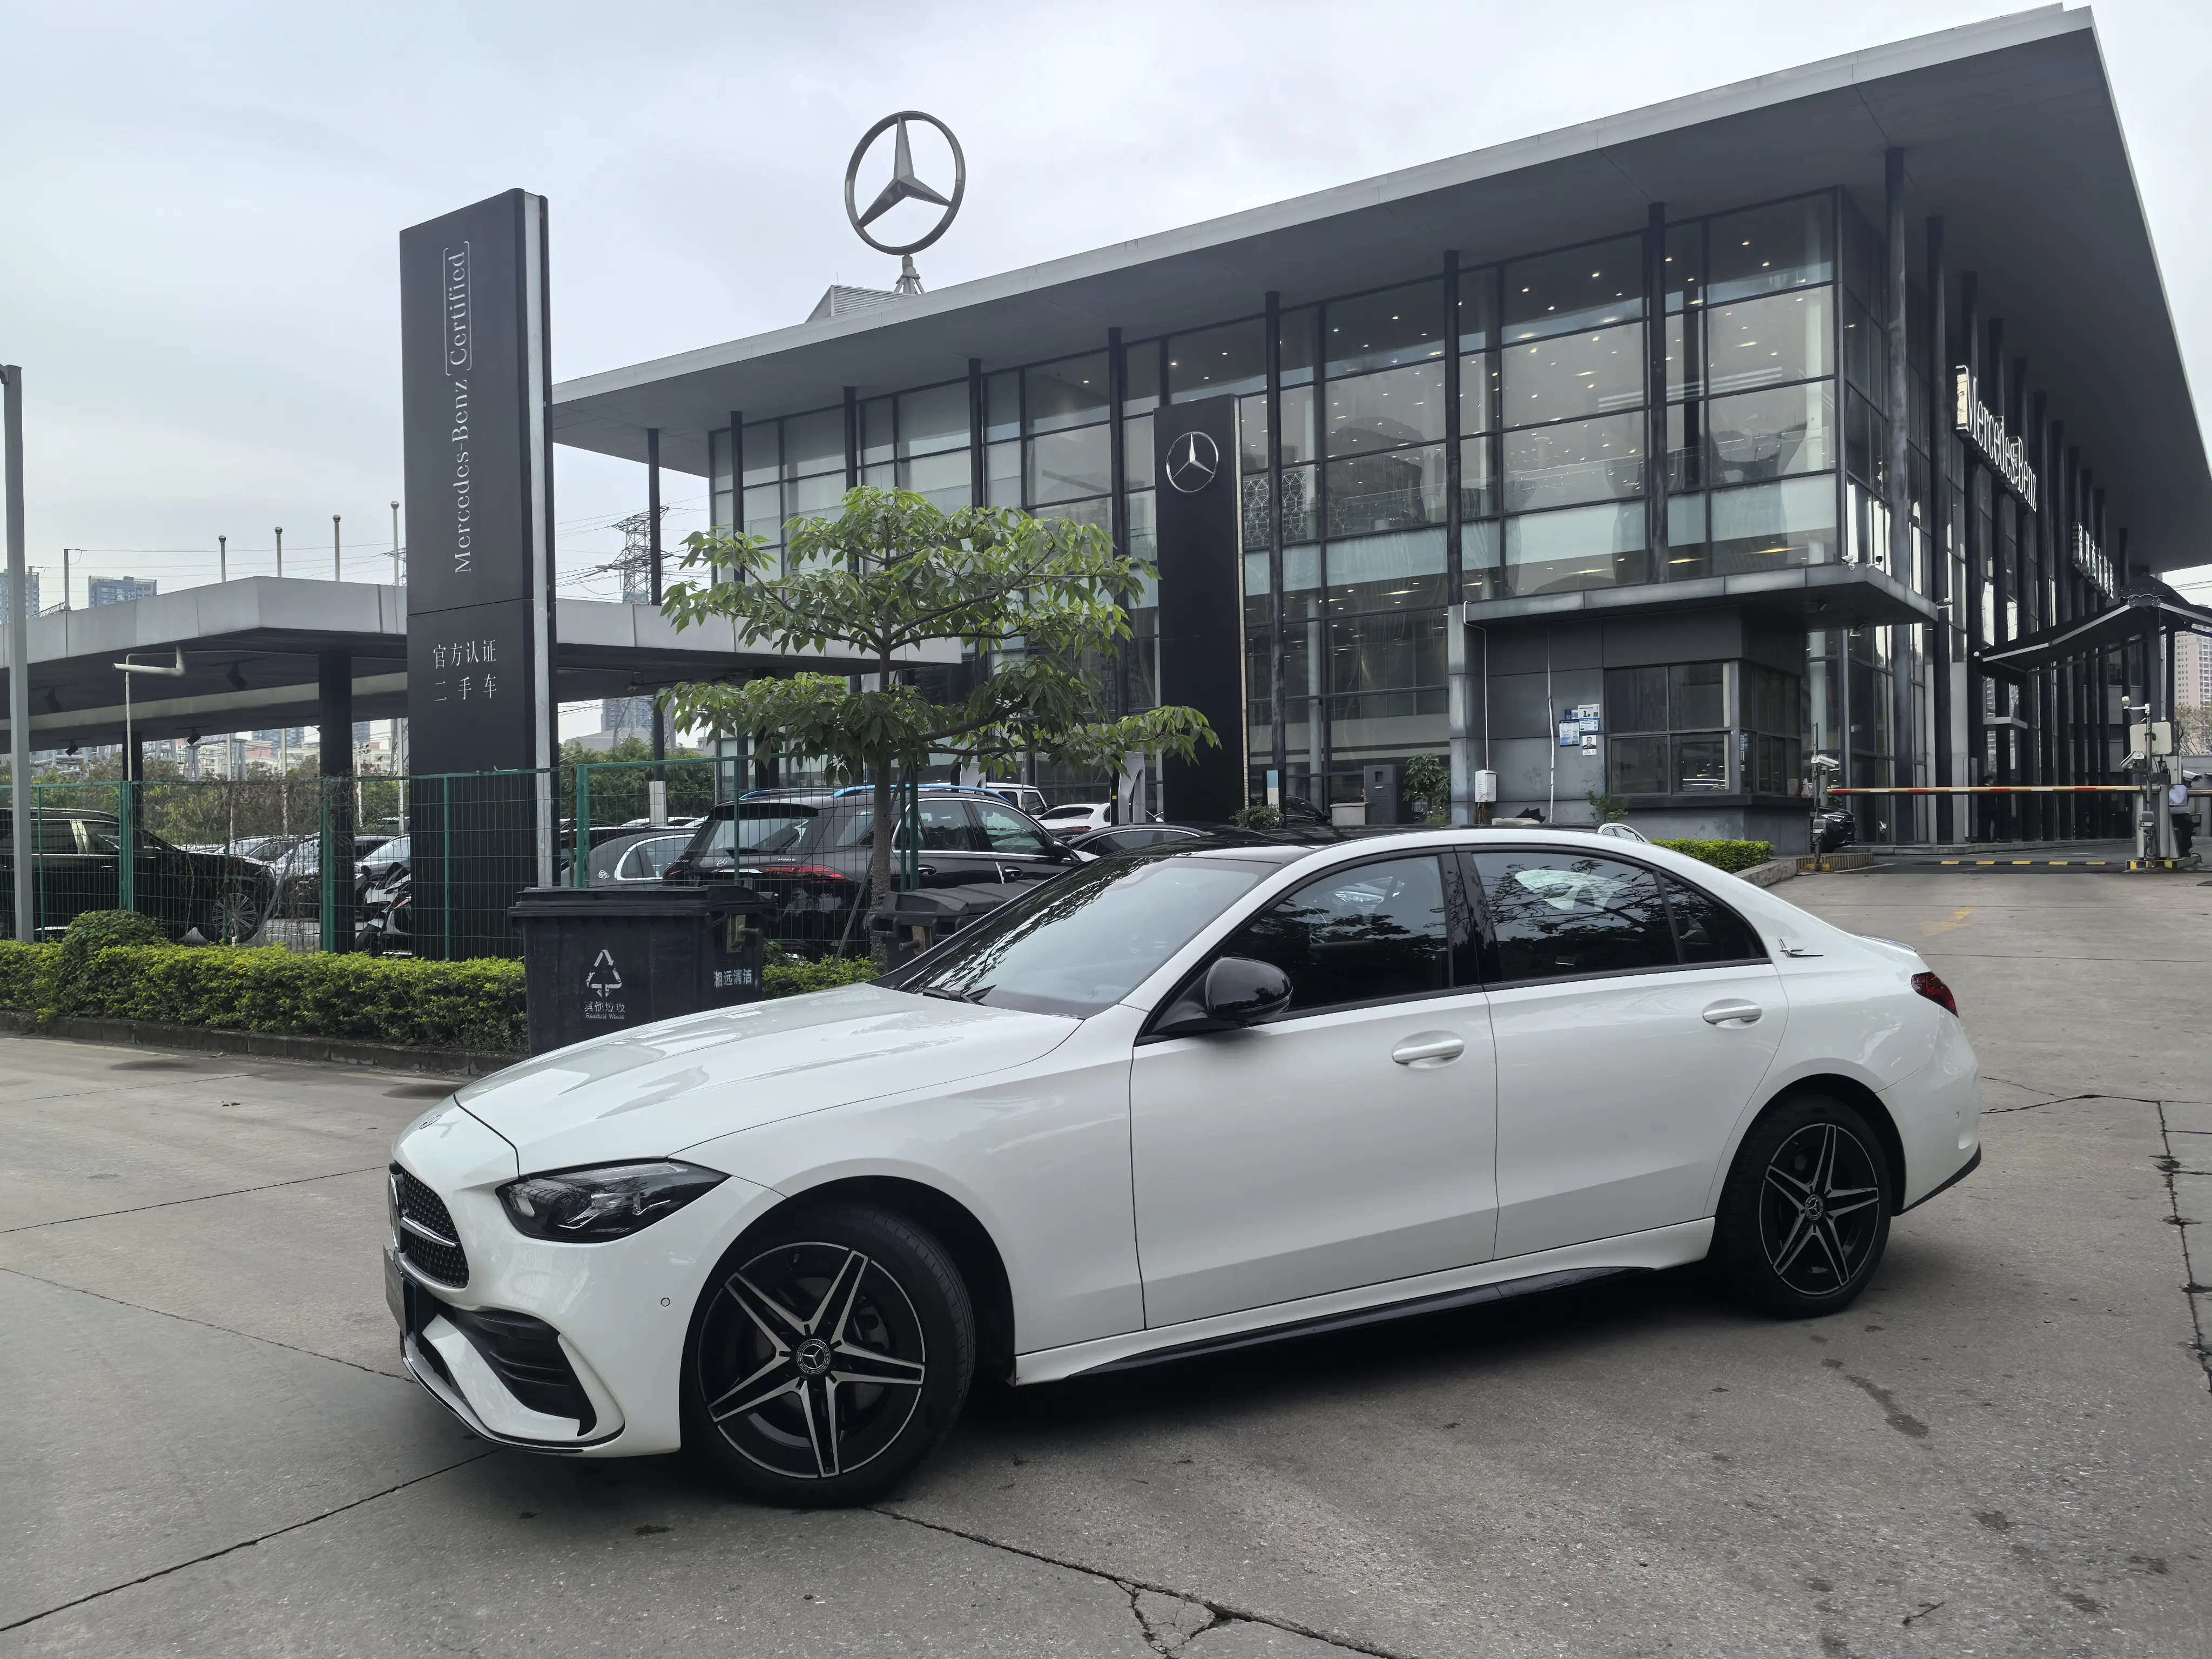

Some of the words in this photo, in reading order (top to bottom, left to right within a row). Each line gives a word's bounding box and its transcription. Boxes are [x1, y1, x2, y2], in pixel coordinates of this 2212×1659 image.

[448, 252, 467, 365] Certified
[1955, 364, 2037, 513] Mercedes-Benz
[452, 379, 471, 573] Mercedes-Benz
[433, 639, 496, 669] 官方认证
[434, 673, 497, 701] 二手车
[713, 968, 752, 988] 湘远清洁
[584, 1001, 625, 1013] 其他垃圾
